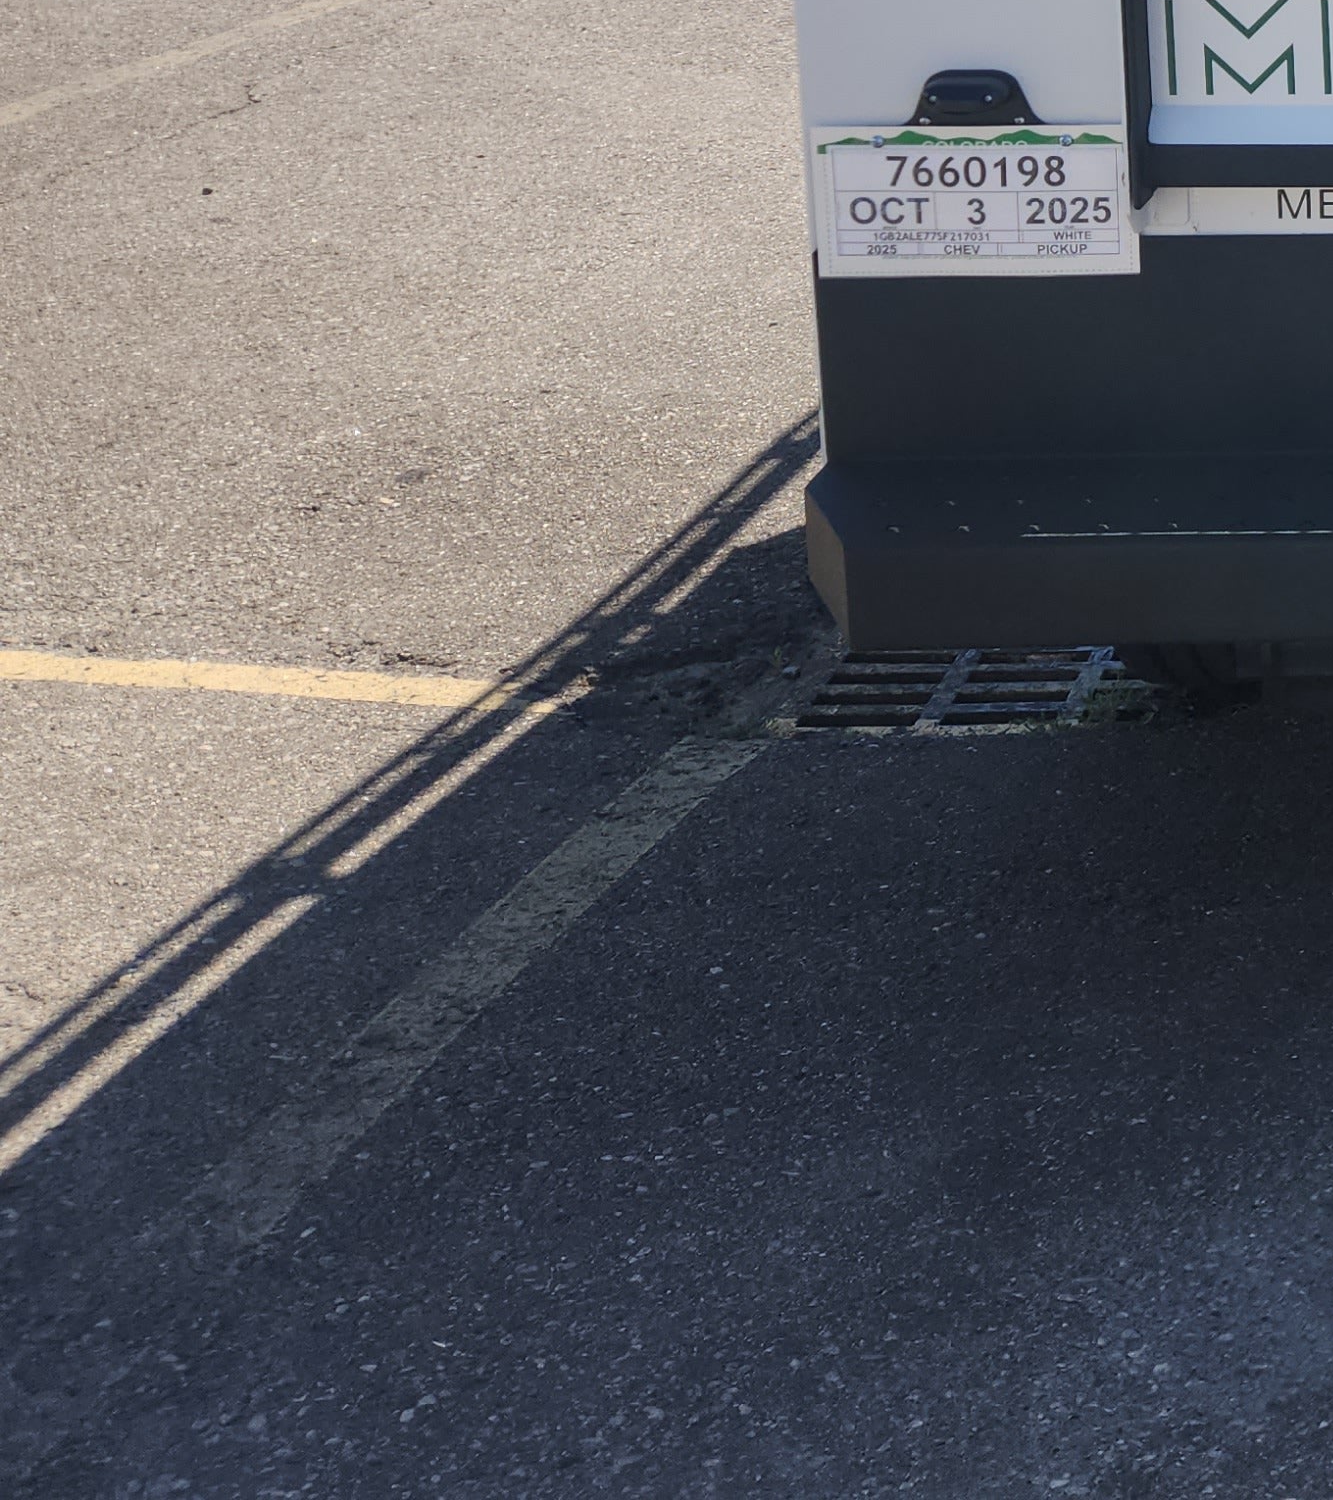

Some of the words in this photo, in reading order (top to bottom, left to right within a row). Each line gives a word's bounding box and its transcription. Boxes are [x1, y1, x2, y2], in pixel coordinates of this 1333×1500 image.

[885, 155, 1067, 188] 7660198
[849, 196, 931, 226] OCT
[966, 198, 987, 225] 3
[1025, 196, 1112, 225] 2025
[1053, 230, 1094, 240] WHITE
[866, 244, 898, 256] 2025
[943, 244, 981, 255] CHEV
[1037, 243, 1088, 255] PICKUP
